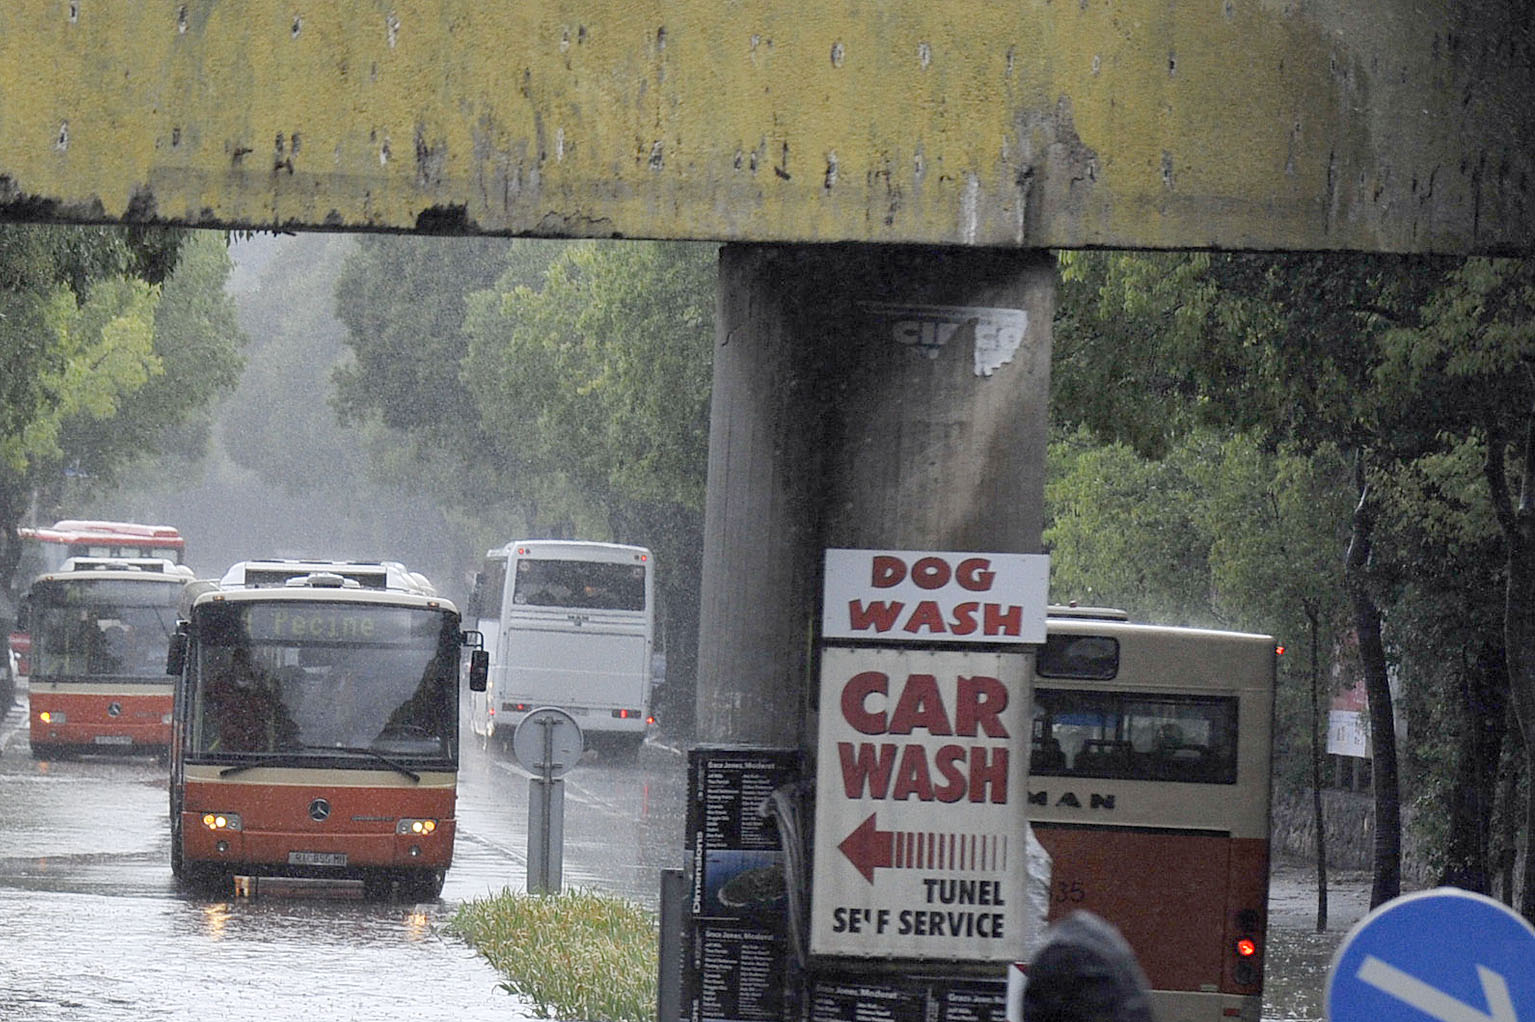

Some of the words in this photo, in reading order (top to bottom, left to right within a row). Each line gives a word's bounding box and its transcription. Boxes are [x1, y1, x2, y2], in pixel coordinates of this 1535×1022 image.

[871, 555, 997, 591] DOG
[848, 599, 1024, 636] WASH
[840, 671, 1010, 738] CAR
[837, 742, 1009, 804] WASH
[1029, 791, 1116, 810] MAN
[692, 831, 704, 914] Dimensions
[923, 878, 1005, 906] TUNEL
[898, 910, 1005, 939] SERVICE
